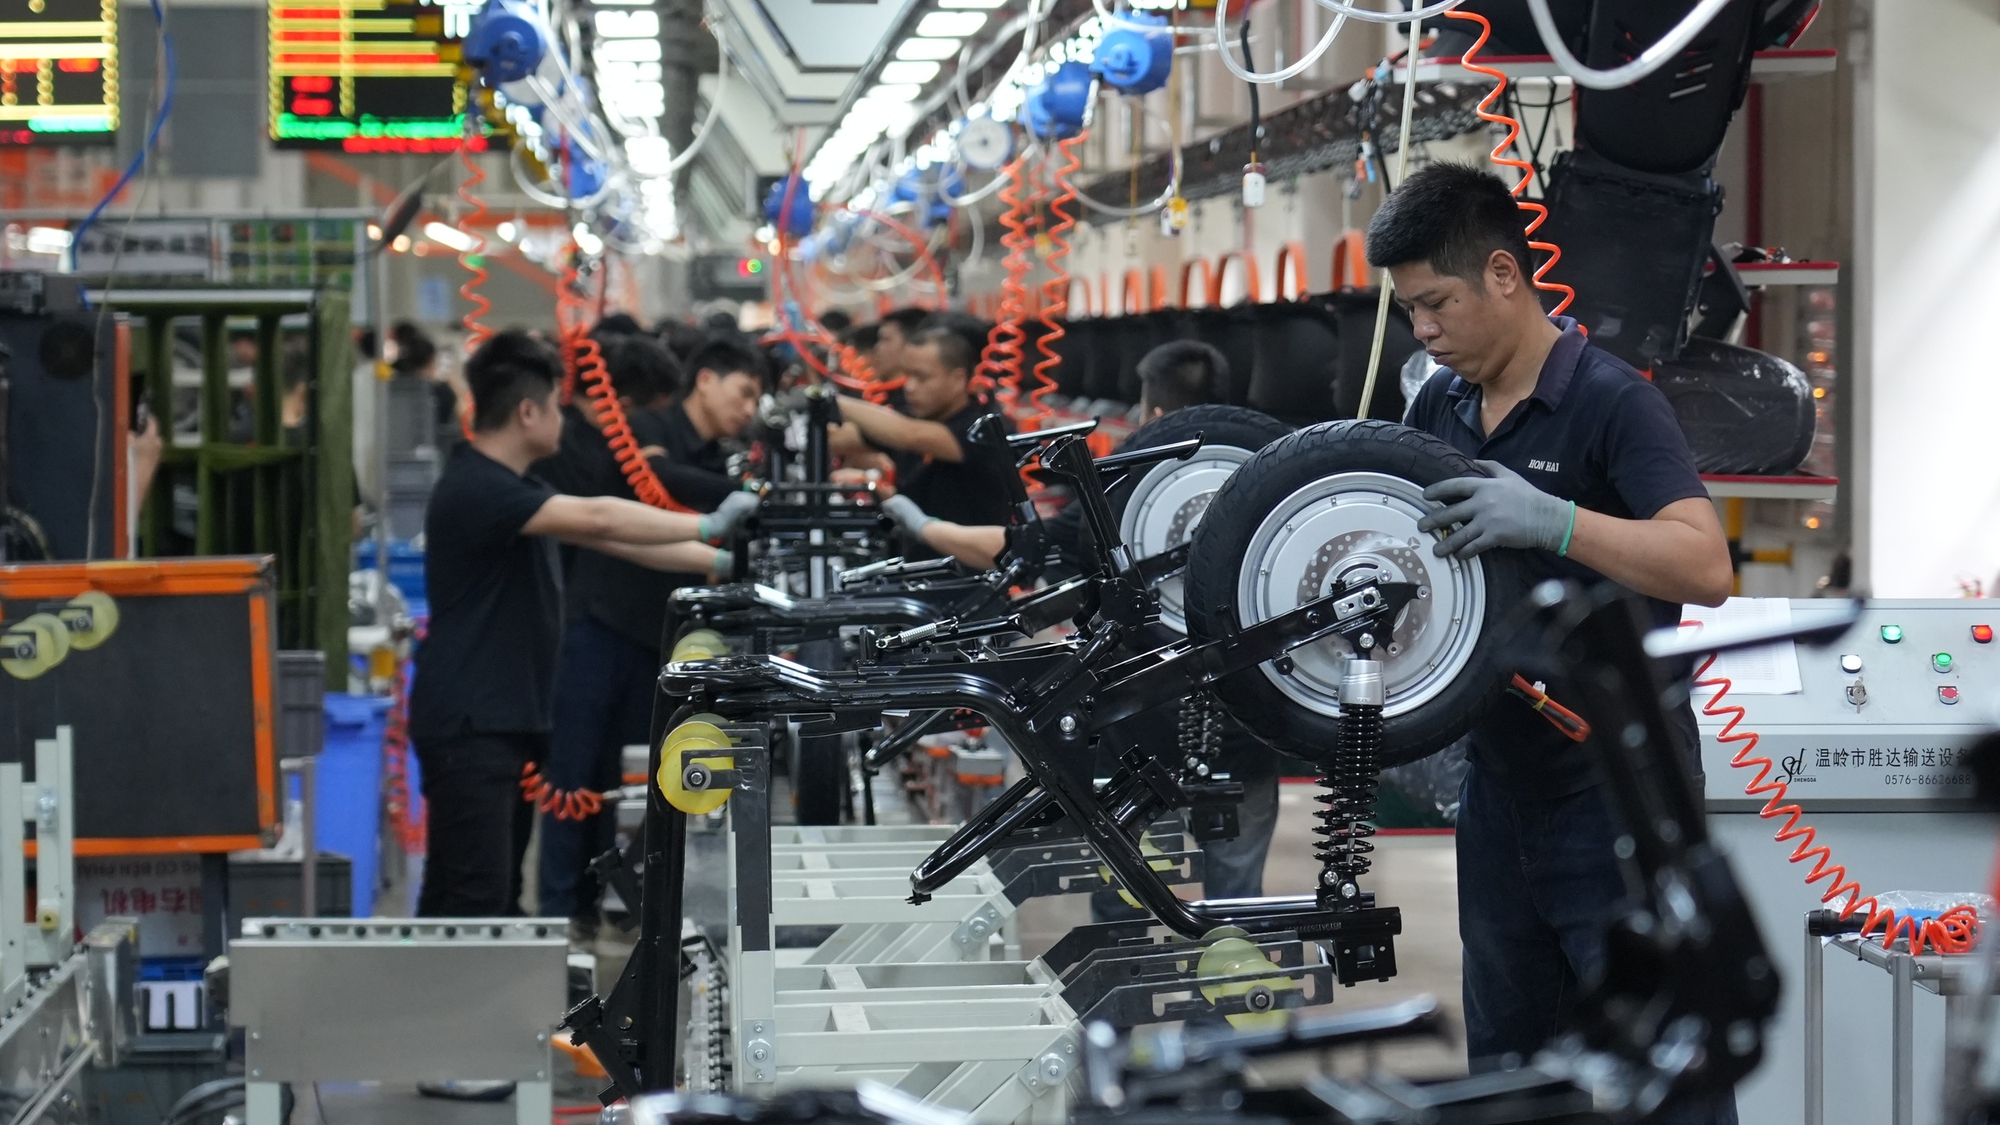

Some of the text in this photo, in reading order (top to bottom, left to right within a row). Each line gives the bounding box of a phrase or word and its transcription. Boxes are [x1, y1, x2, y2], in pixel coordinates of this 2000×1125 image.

[1528, 459, 1559, 472] HON HAI
[1885, 774, 1971, 785] 0576-86626688
